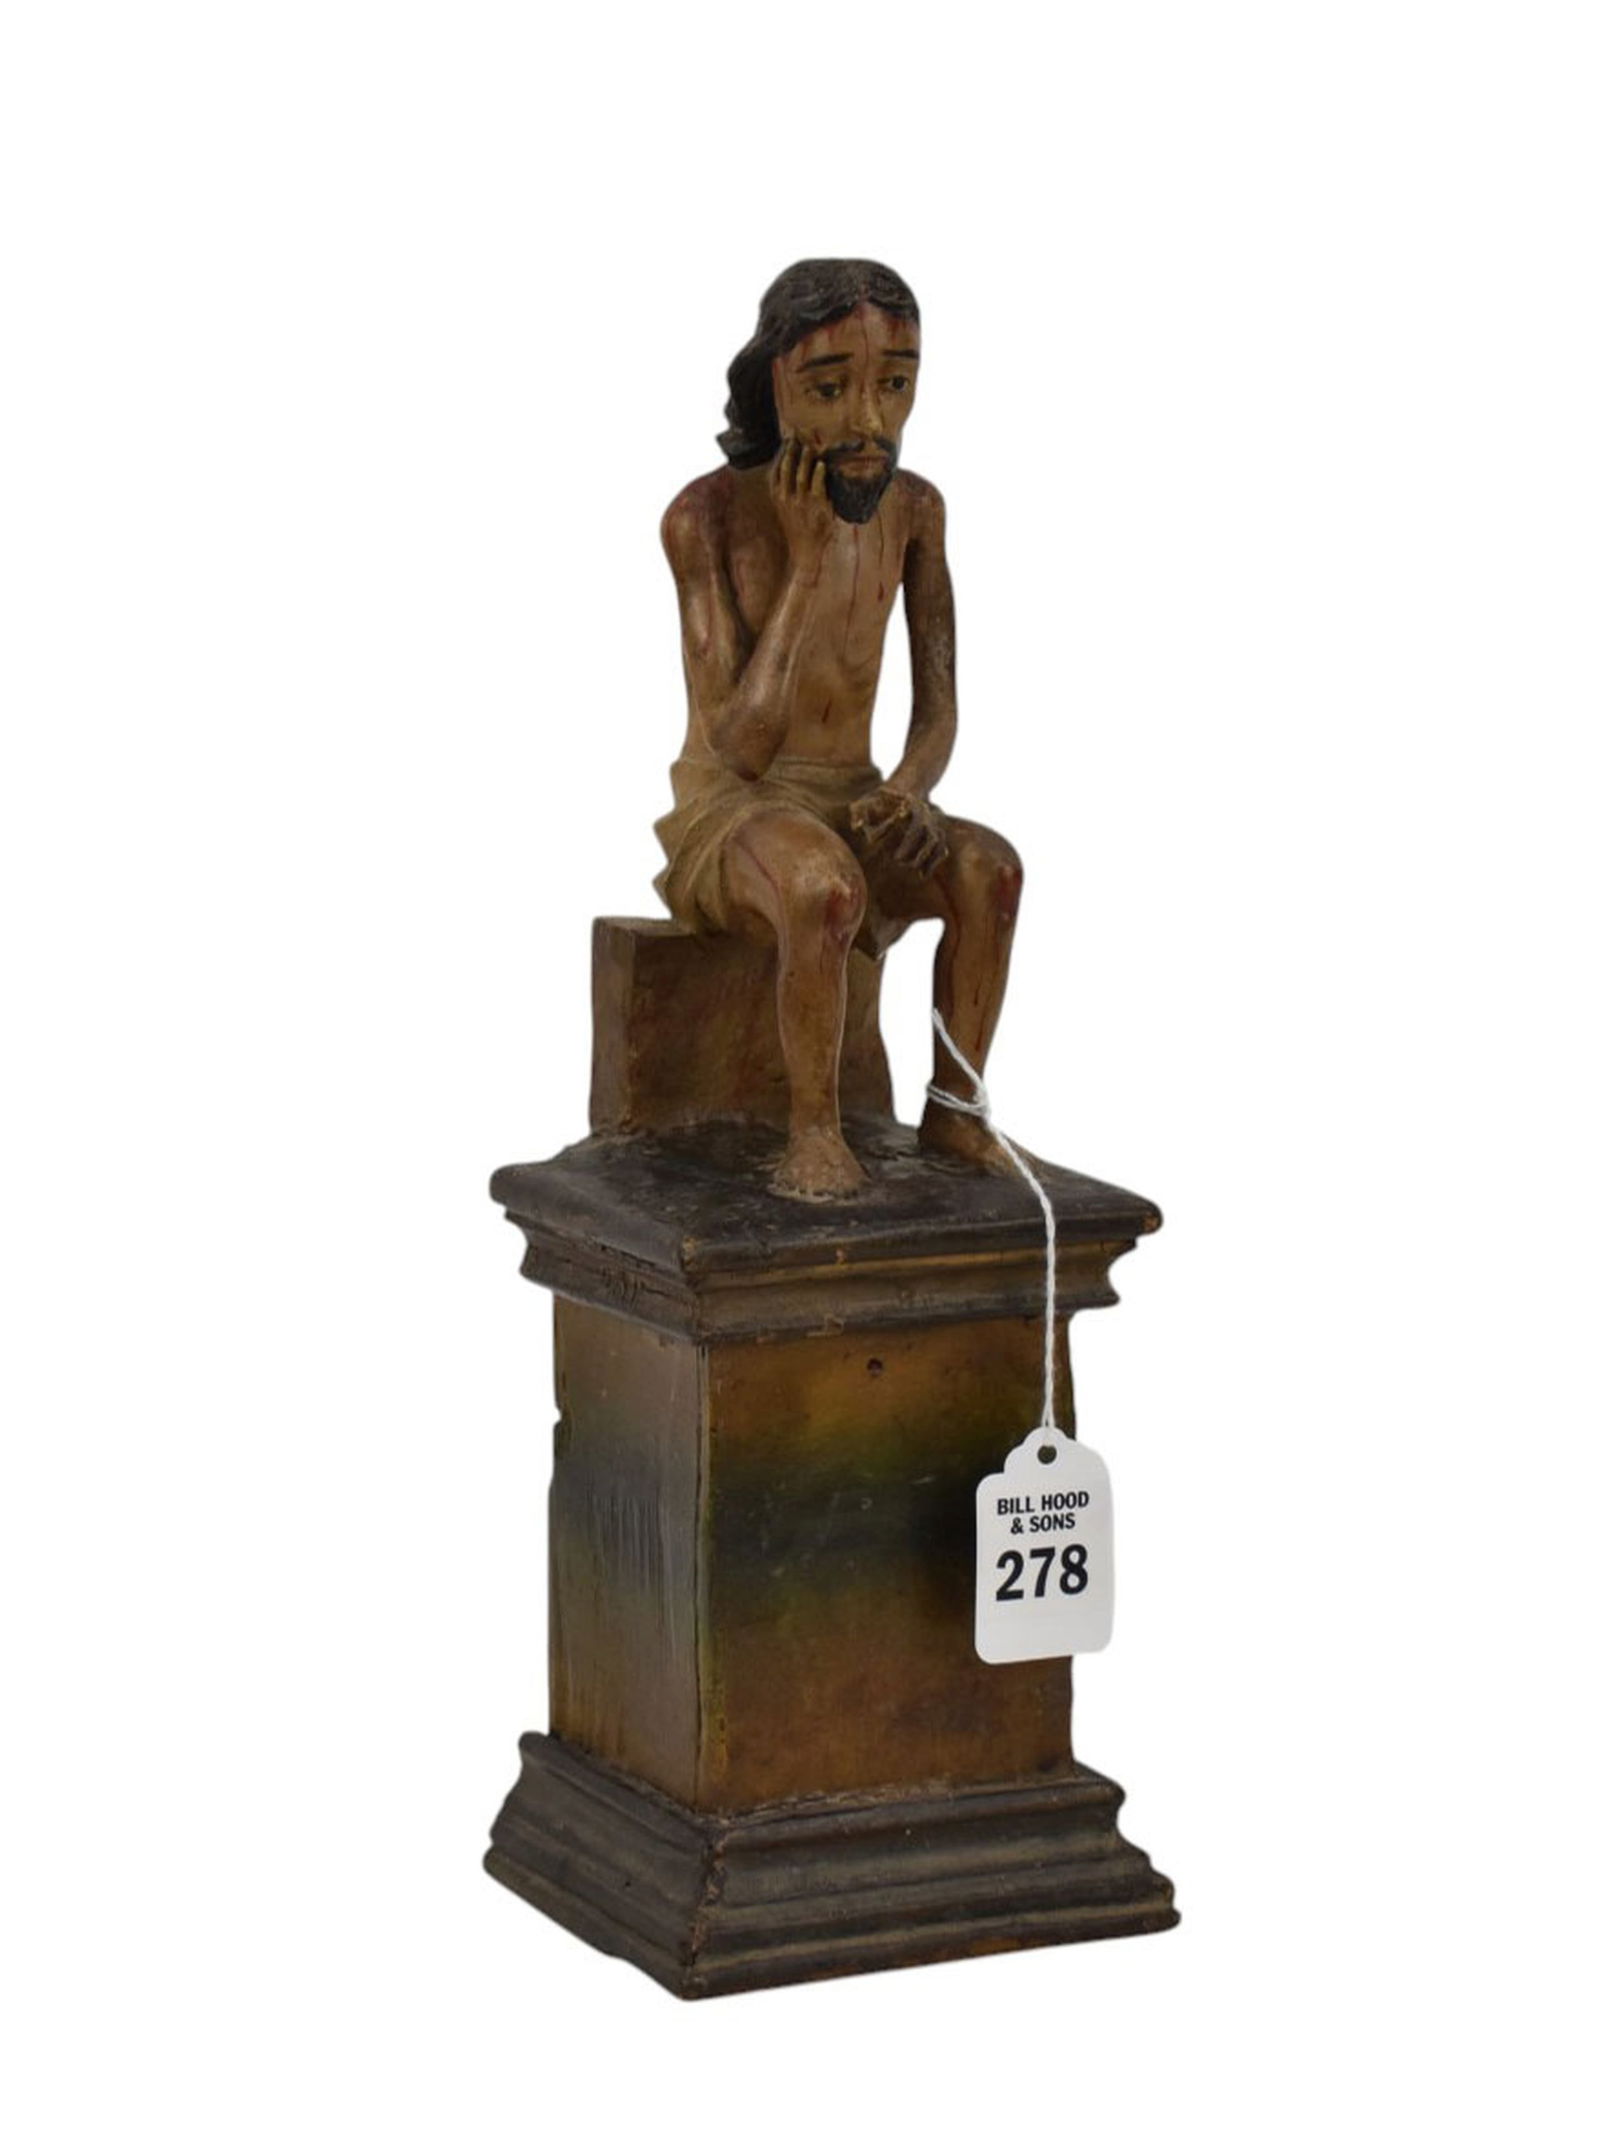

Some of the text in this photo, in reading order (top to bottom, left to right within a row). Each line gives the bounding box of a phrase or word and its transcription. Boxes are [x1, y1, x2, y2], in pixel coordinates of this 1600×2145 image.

[997, 1490, 1090, 1516] BILL HOOD
[1010, 1512, 1076, 1535] & SONS
[995, 1543, 1089, 1602] 278
